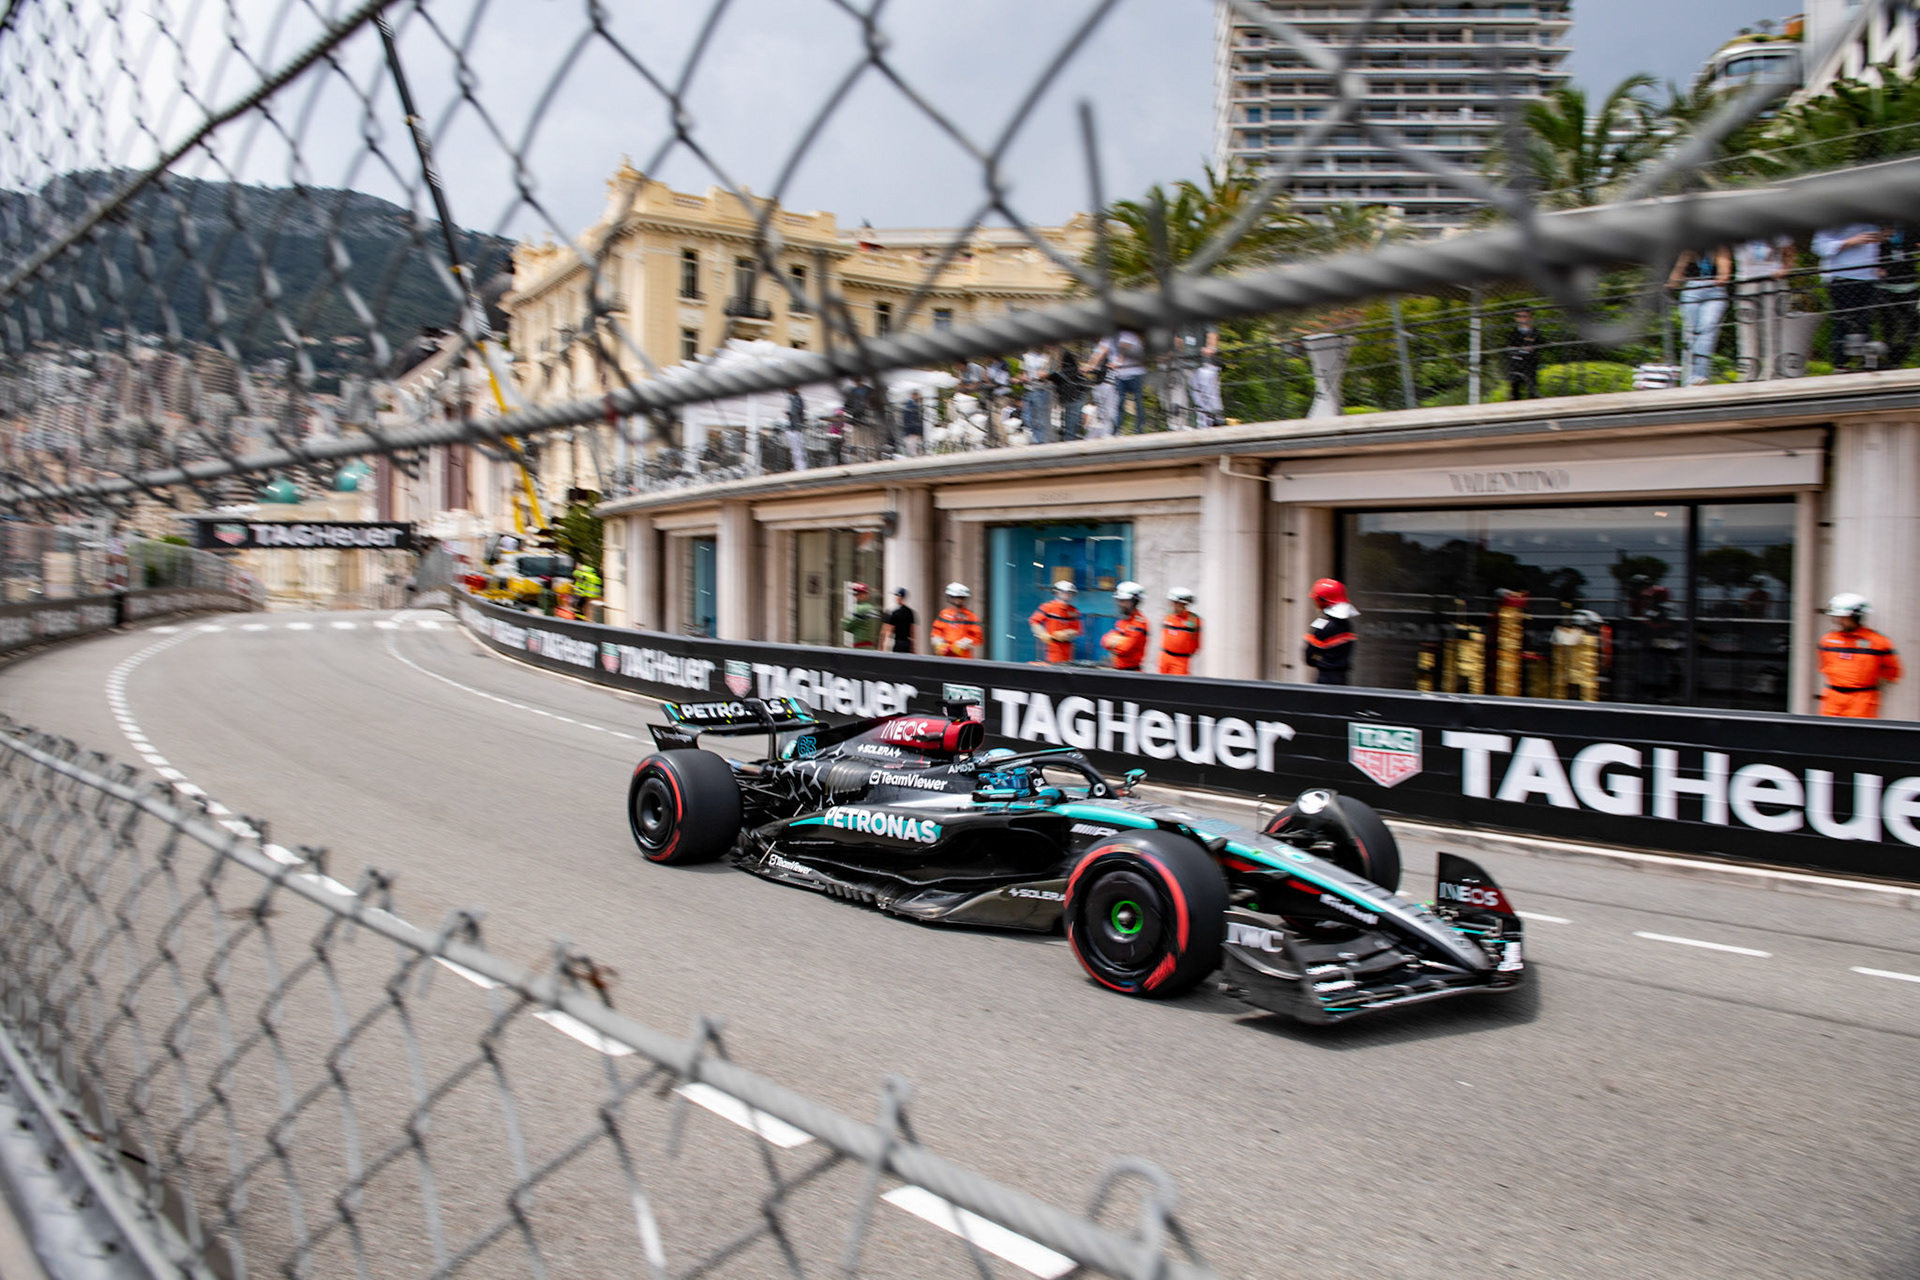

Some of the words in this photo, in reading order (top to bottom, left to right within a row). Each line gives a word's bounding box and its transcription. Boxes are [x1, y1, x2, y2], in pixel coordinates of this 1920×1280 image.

[680, 700, 784, 719] PETROS
[881, 720, 928, 742] INEOS
[1354, 727, 1416, 751] TAG
[863, 744, 894, 757] SOLERA
[881, 772, 948, 791] TeamViewer
[824, 806, 938, 844] PETRONAS
[1439, 882, 1499, 906] INEOS
